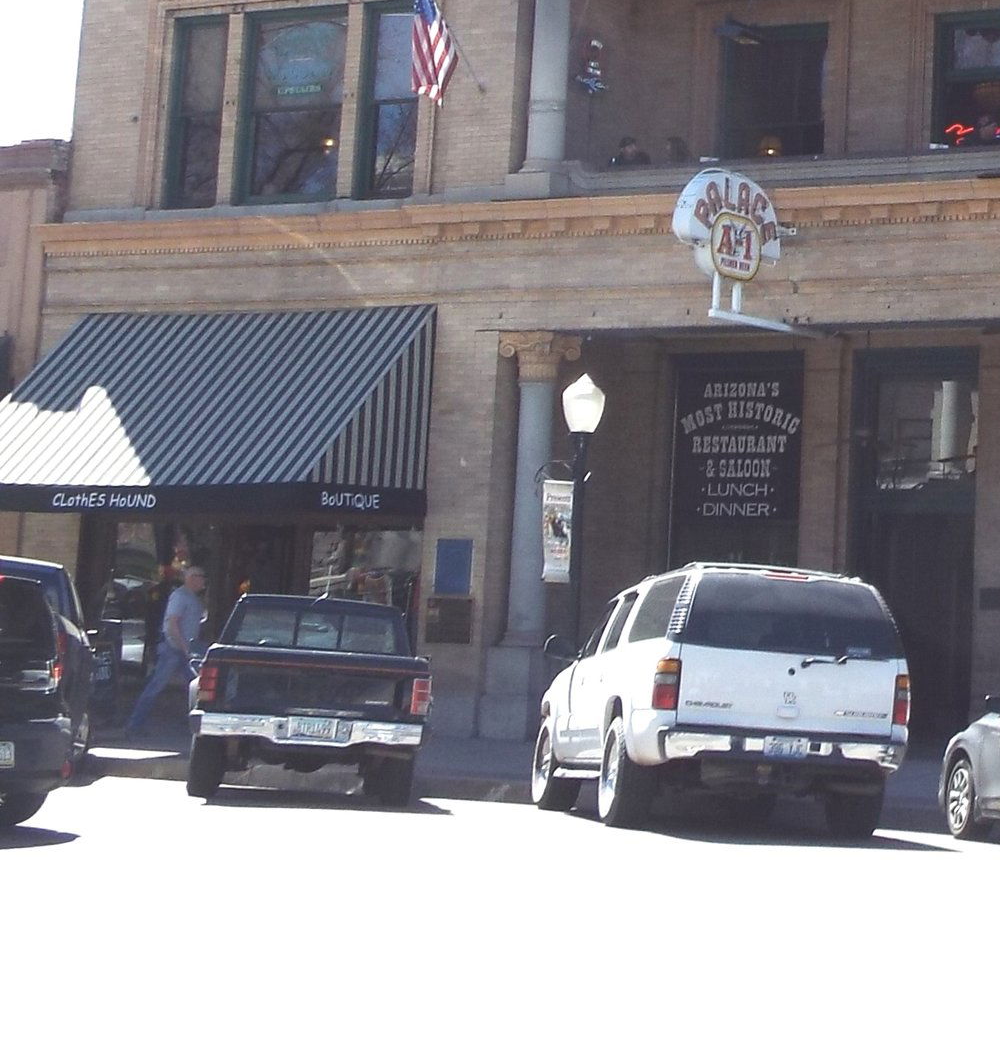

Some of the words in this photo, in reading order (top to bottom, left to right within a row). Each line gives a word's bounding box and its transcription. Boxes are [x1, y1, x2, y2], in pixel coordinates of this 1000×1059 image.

[694, 177, 778, 246] PALACE
[704, 382, 780, 398] ARIZONA'S
[680, 403, 723, 434] MOST
[728, 400, 801, 435] HISTORIC
[692, 435, 788, 453] RESTAURANT
[706, 458, 716, 478] &
[719, 458, 771, 478] SALOON
[707, 483, 768, 497] LUNCH
[702, 502, 770, 517] DINNER
